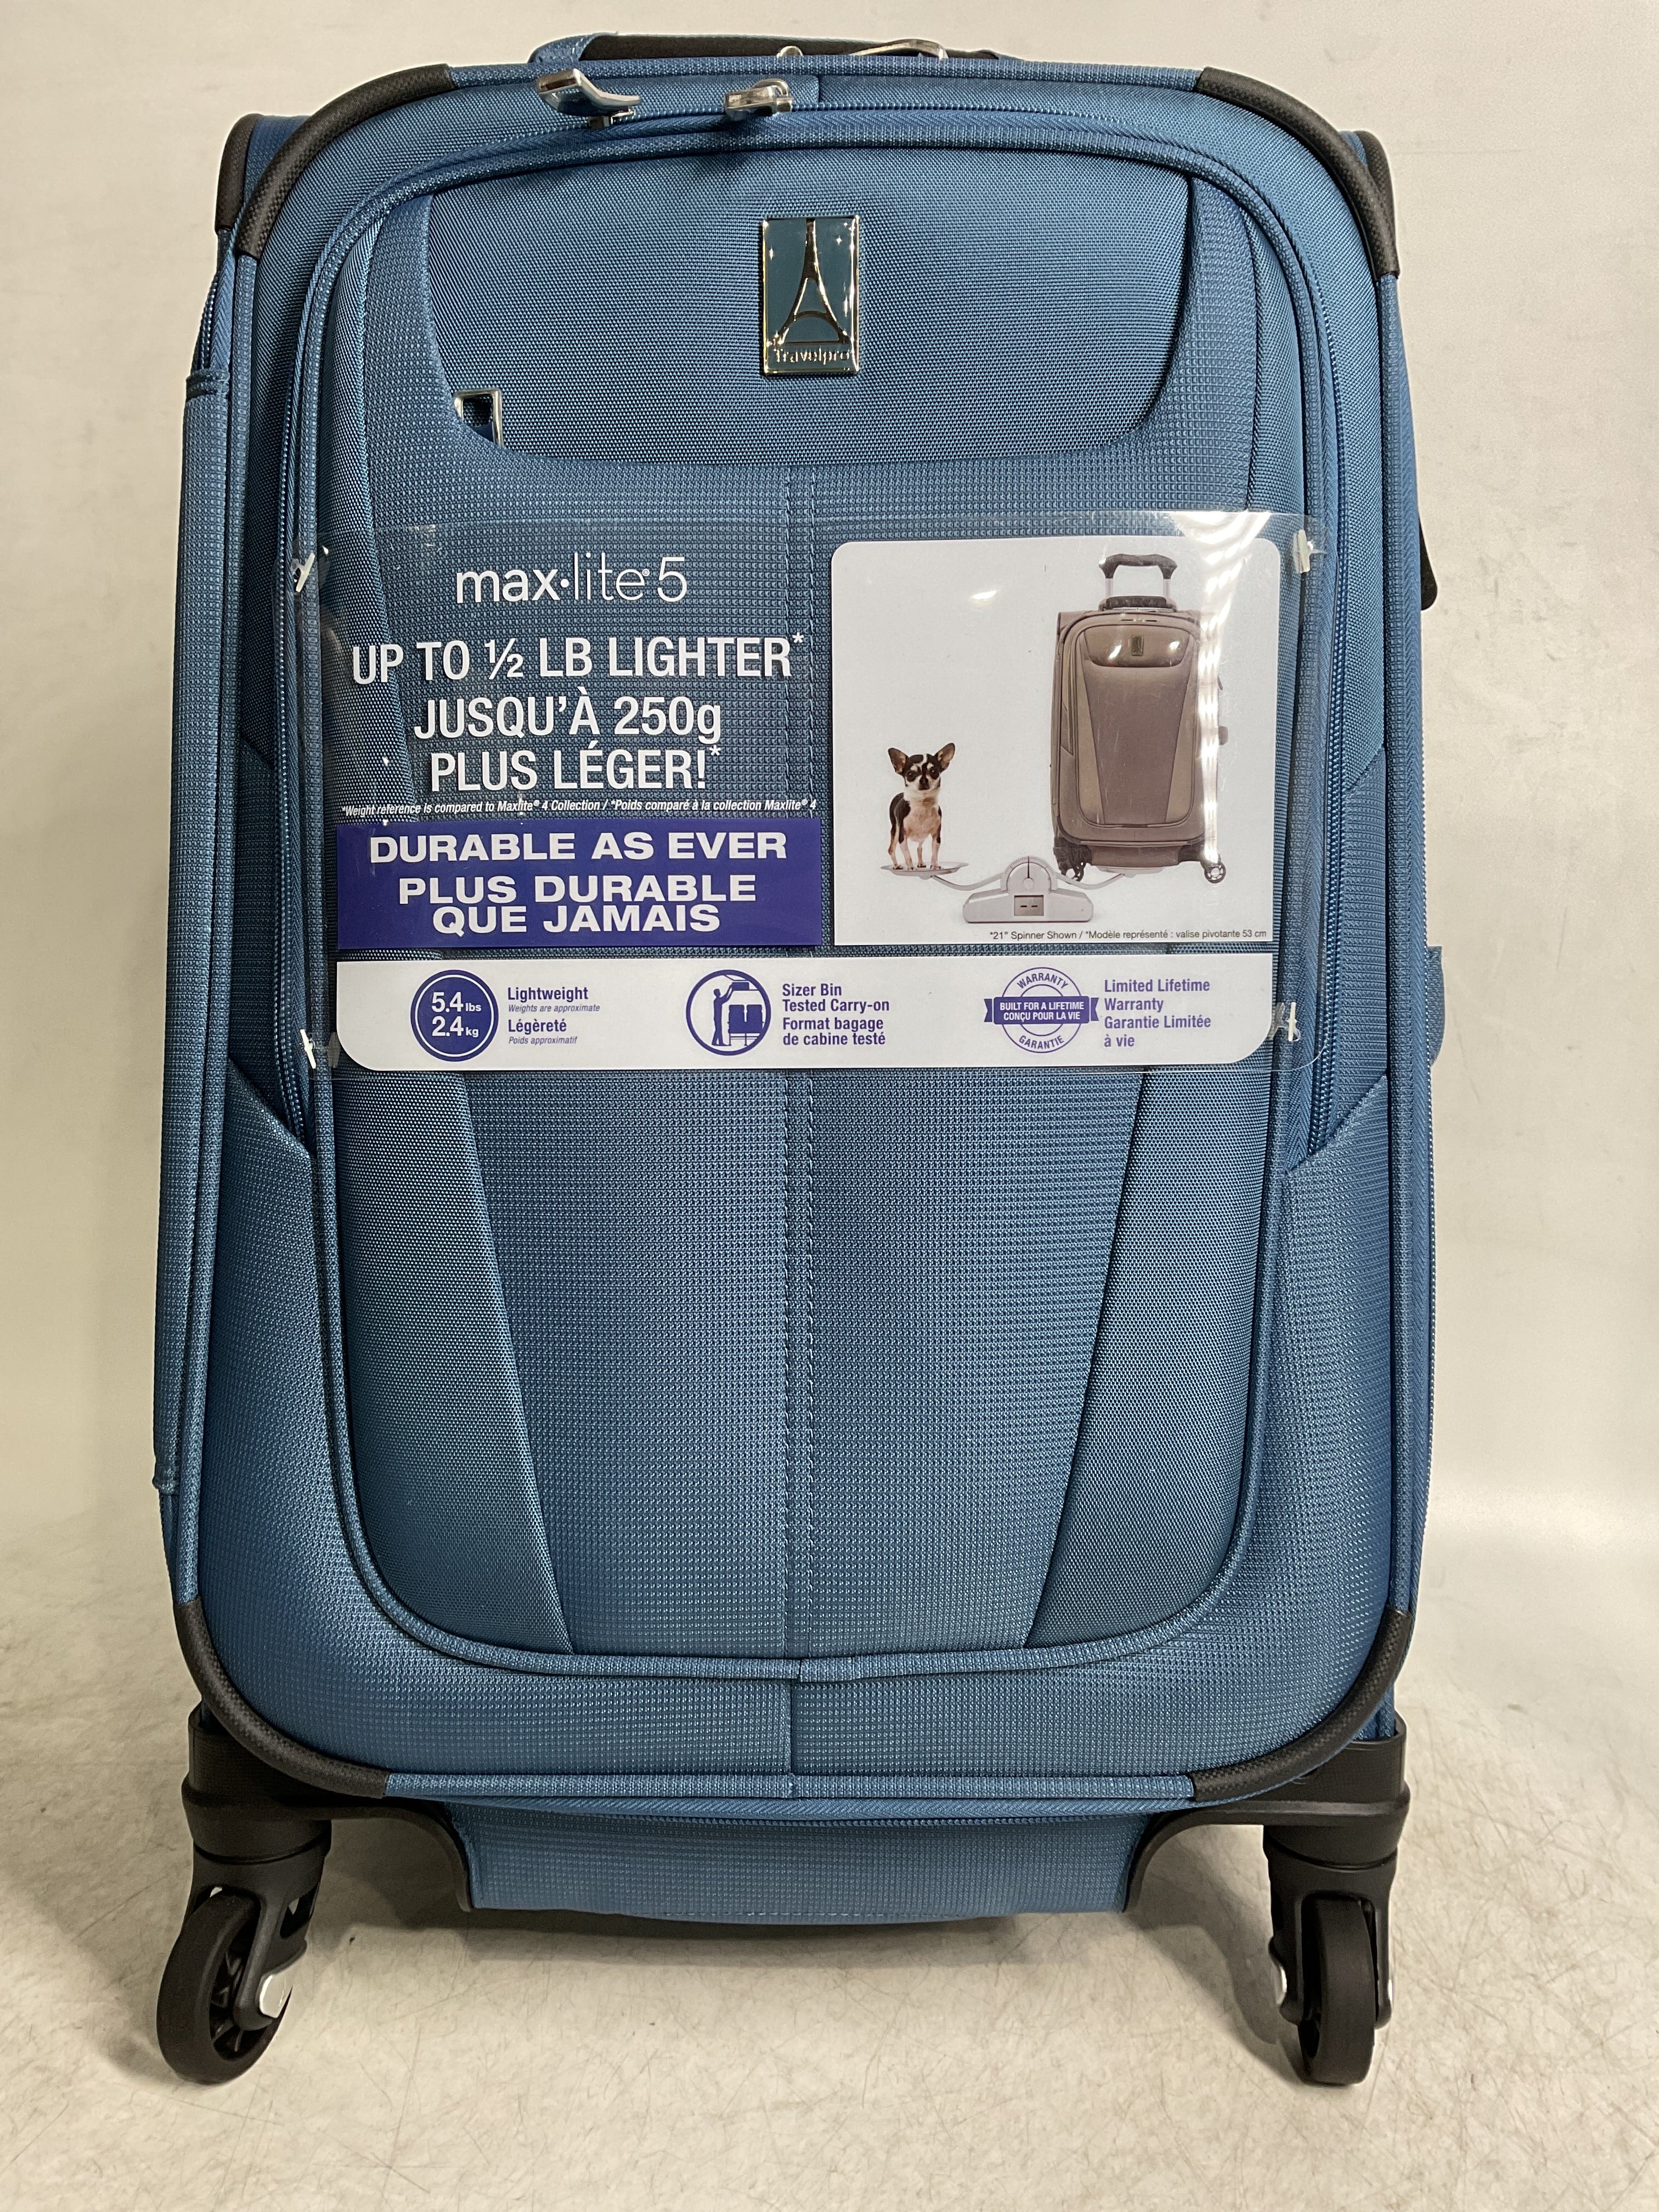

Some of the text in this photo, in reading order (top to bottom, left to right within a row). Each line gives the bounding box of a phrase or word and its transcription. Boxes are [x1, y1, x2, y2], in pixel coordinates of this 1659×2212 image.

[659, 556, 687, 602] 5
[352, 644, 403, 685] UP
[416, 640, 470, 681] TO
[540, 637, 592, 678] LB
[613, 696, 721, 743] 250g
[431, 750, 537, 792] PLUS
[377, 803, 421, 814] reference
[423, 803, 432, 813] is
[434, 802, 483, 815] compared
[485, 802, 494, 812] to
[541, 801, 548, 810] 4
[551, 799, 600, 810] Collection
[645, 799, 689, 813] comparé
[691, 798, 699, 810] à
[701, 800, 710, 810] la
[713, 799, 761, 810] collection
[810, 800, 816, 810] 4
[370, 831, 787, 864] DURABLE AS EVER
[399, 874, 755, 905] PLUS DURABLE
[433, 905, 720, 938] QUE JAMAIS
[1011, 932, 1043, 941] Spinner
[1047, 930, 1076, 939] Shown
[1122, 930, 1168, 941] représenté
[1202, 930, 1240, 940] pivotante
[1017, 973, 1069, 989] WARRANTY
[1104, 979, 1210, 992] Limited Lifetime
[507, 986, 588, 1002] Lightweight
[782, 983, 842, 996] Sizer Bin
[508, 1004, 537, 1013] Weights
[554, 1003, 600, 1014] approximate
[782, 998, 889, 1014] Tested Carry-on
[1000, 1001, 1084, 1011] BUILT FOR A LIFETIME
[1104, 997, 1164, 1013] Warranty
[783, 1017, 883, 1032] Format bagage
[1003, 1012, 1031, 1022] CONÇU
[1033, 1012, 1054, 1020] POUR
[1067, 1012, 1080, 1020] VIE
[1104, 1015, 1211, 1029] Garantie Limitée
[508, 1019, 567, 1035] Légèreté
[509, 1036, 578, 1046] Poids approximatif
[783, 1032, 885, 1046] de cabine testé
[1019, 1035, 1064, 1050] GARANTIE
[1104, 1034, 1135, 1047] à vie
